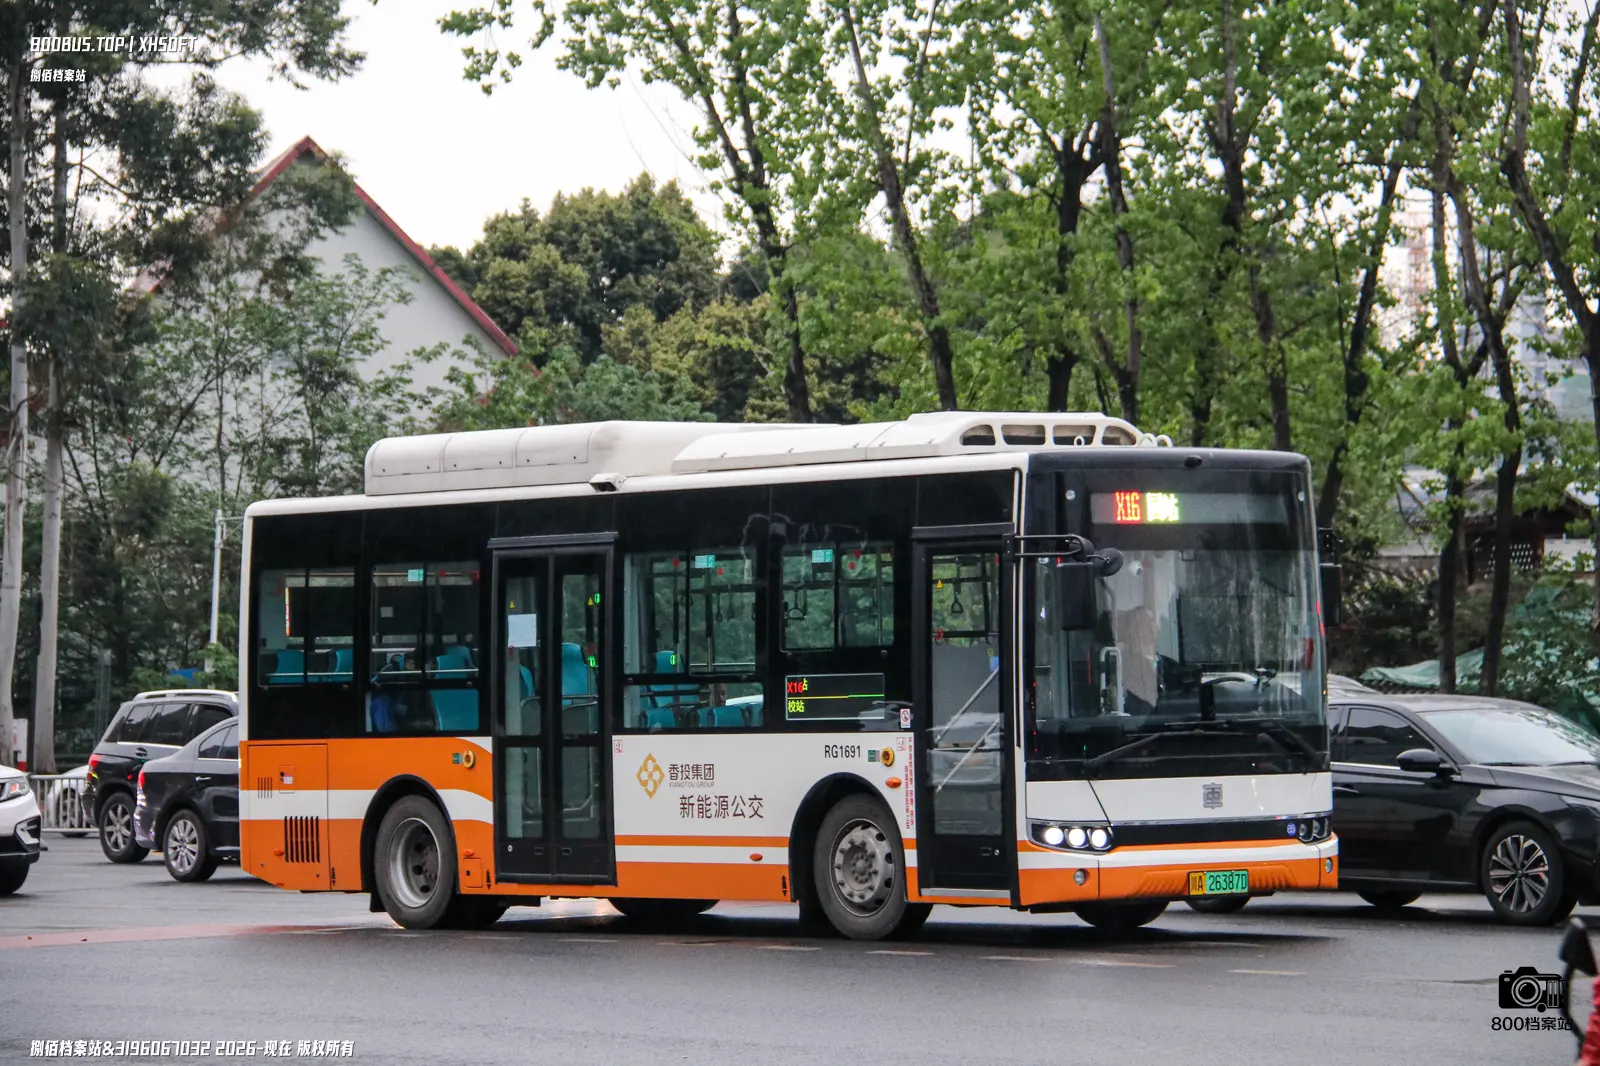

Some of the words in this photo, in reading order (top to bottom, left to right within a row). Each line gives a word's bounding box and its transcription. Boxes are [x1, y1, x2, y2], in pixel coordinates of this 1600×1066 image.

[1115, 492, 1141, 521] X16
[787, 681, 803, 693] X16
[824, 745, 861, 759] RG1691
[668, 764, 715, 781] 香投集团
[680, 795, 763, 819] 新能源公交
[1208, 874, 1247, 891] 26387D
